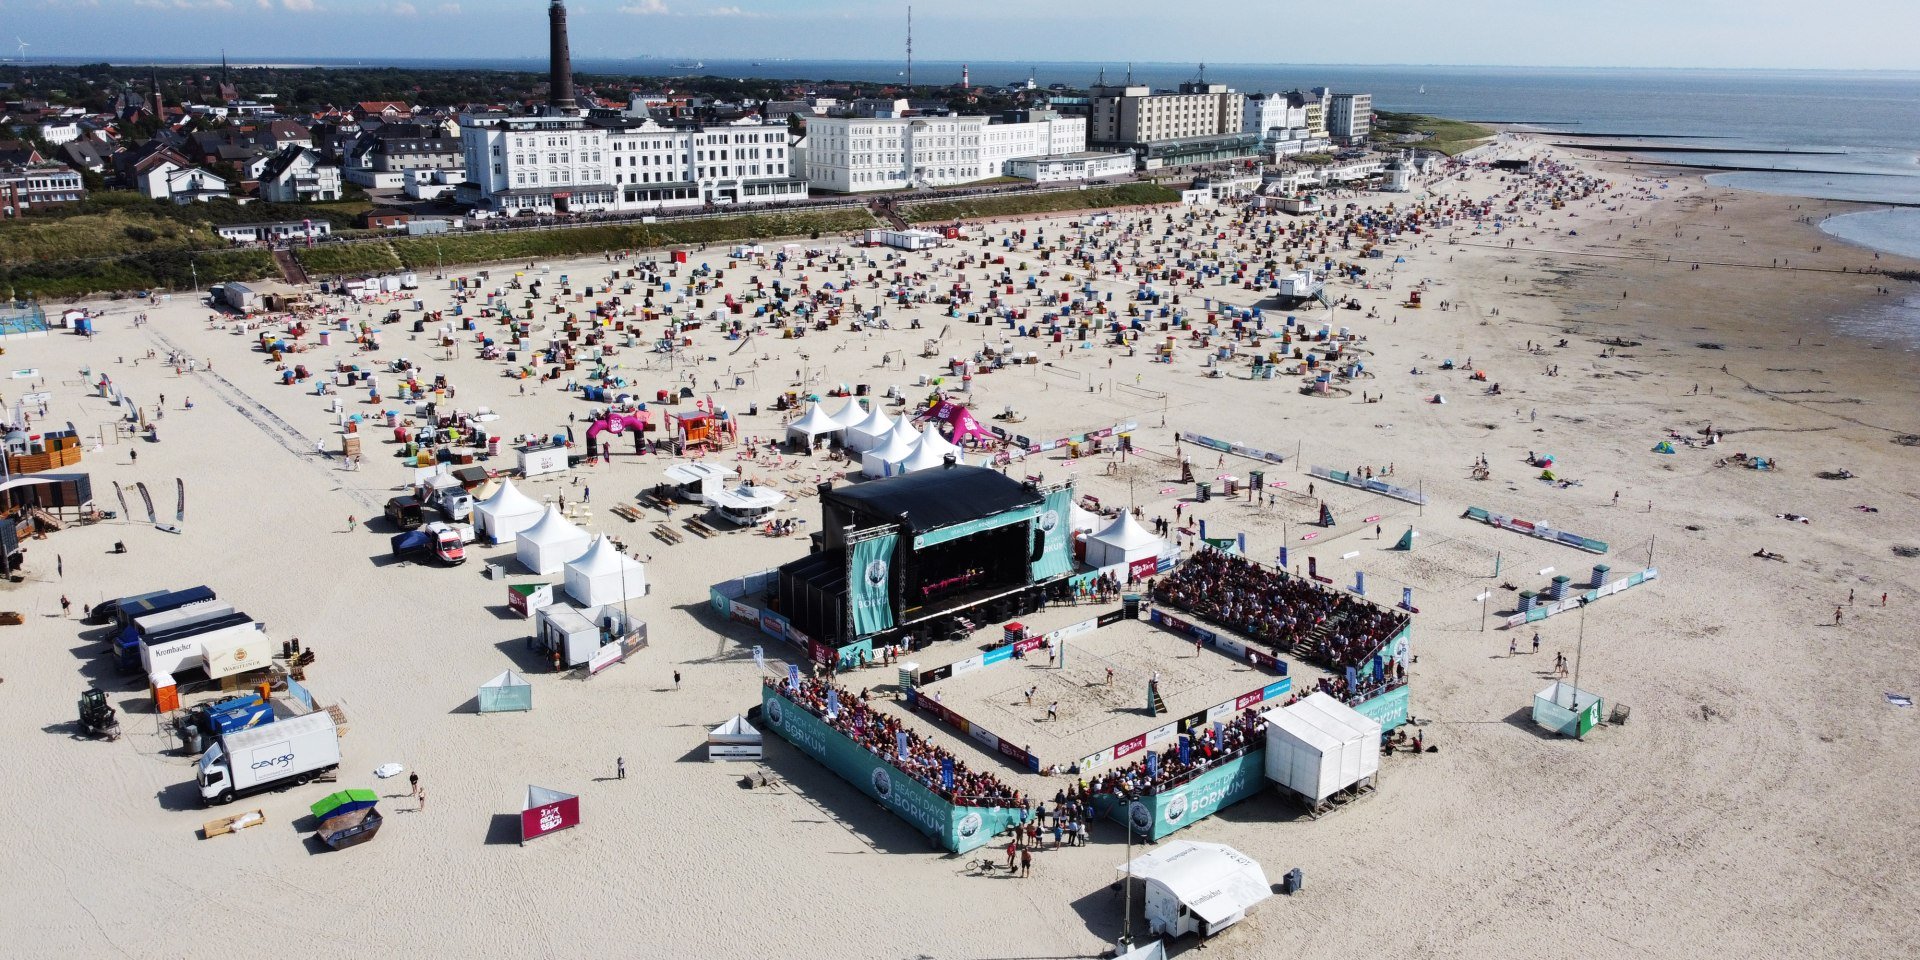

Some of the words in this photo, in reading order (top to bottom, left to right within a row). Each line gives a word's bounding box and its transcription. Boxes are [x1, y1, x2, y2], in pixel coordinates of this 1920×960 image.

[155, 643, 191, 657] Krombacher
[784, 720, 826, 756] BORKUM
[251, 753, 294, 769] cargo
[895, 780, 921, 804] BEACH
[923, 801, 946, 821] DAYS
[1190, 778, 1245, 813] BORKUM
[893, 793, 945, 836] BORKUM
